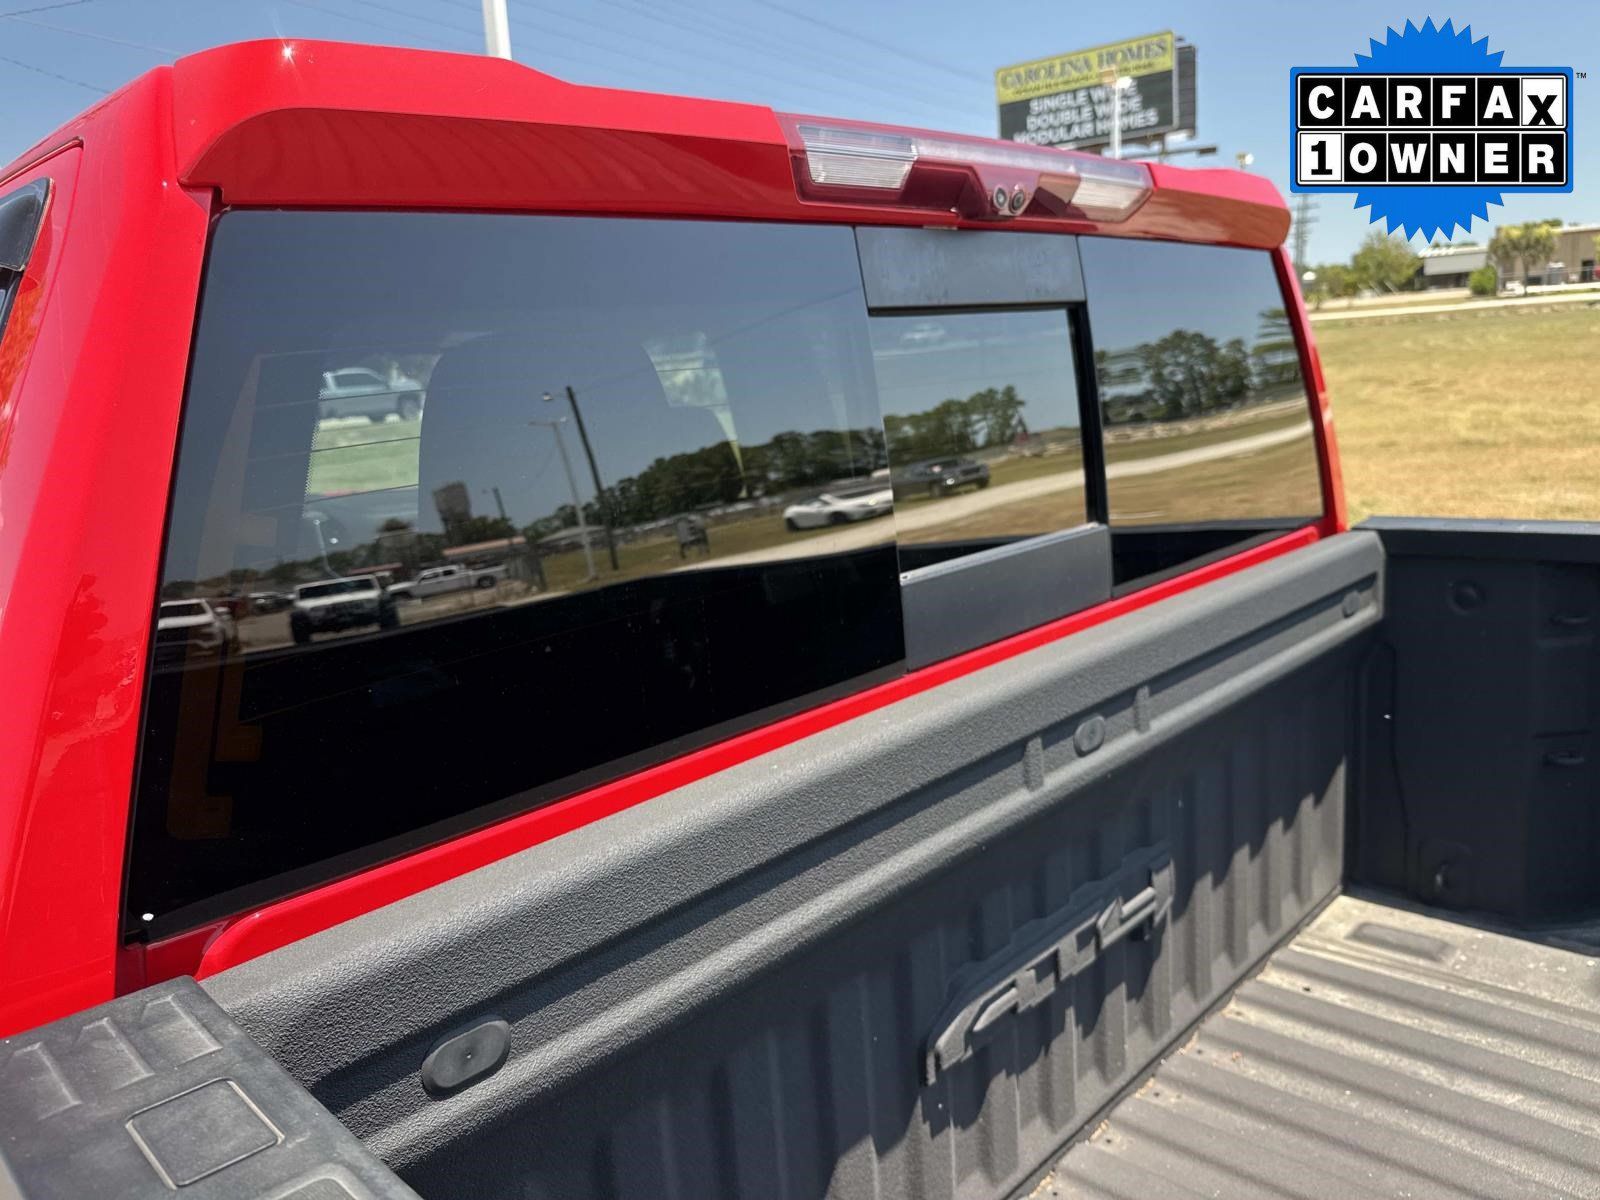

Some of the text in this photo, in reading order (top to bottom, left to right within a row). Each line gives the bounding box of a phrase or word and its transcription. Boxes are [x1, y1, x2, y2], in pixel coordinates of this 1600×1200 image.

[1000, 57, 1091, 88] CAROLINA
[1097, 39, 1167, 68] HOMES
[1029, 79, 1138, 114] SINGLE WIE
[1013, 122, 1094, 144] MODULAR
[1026, 105, 1093, 131] DOUBLE
